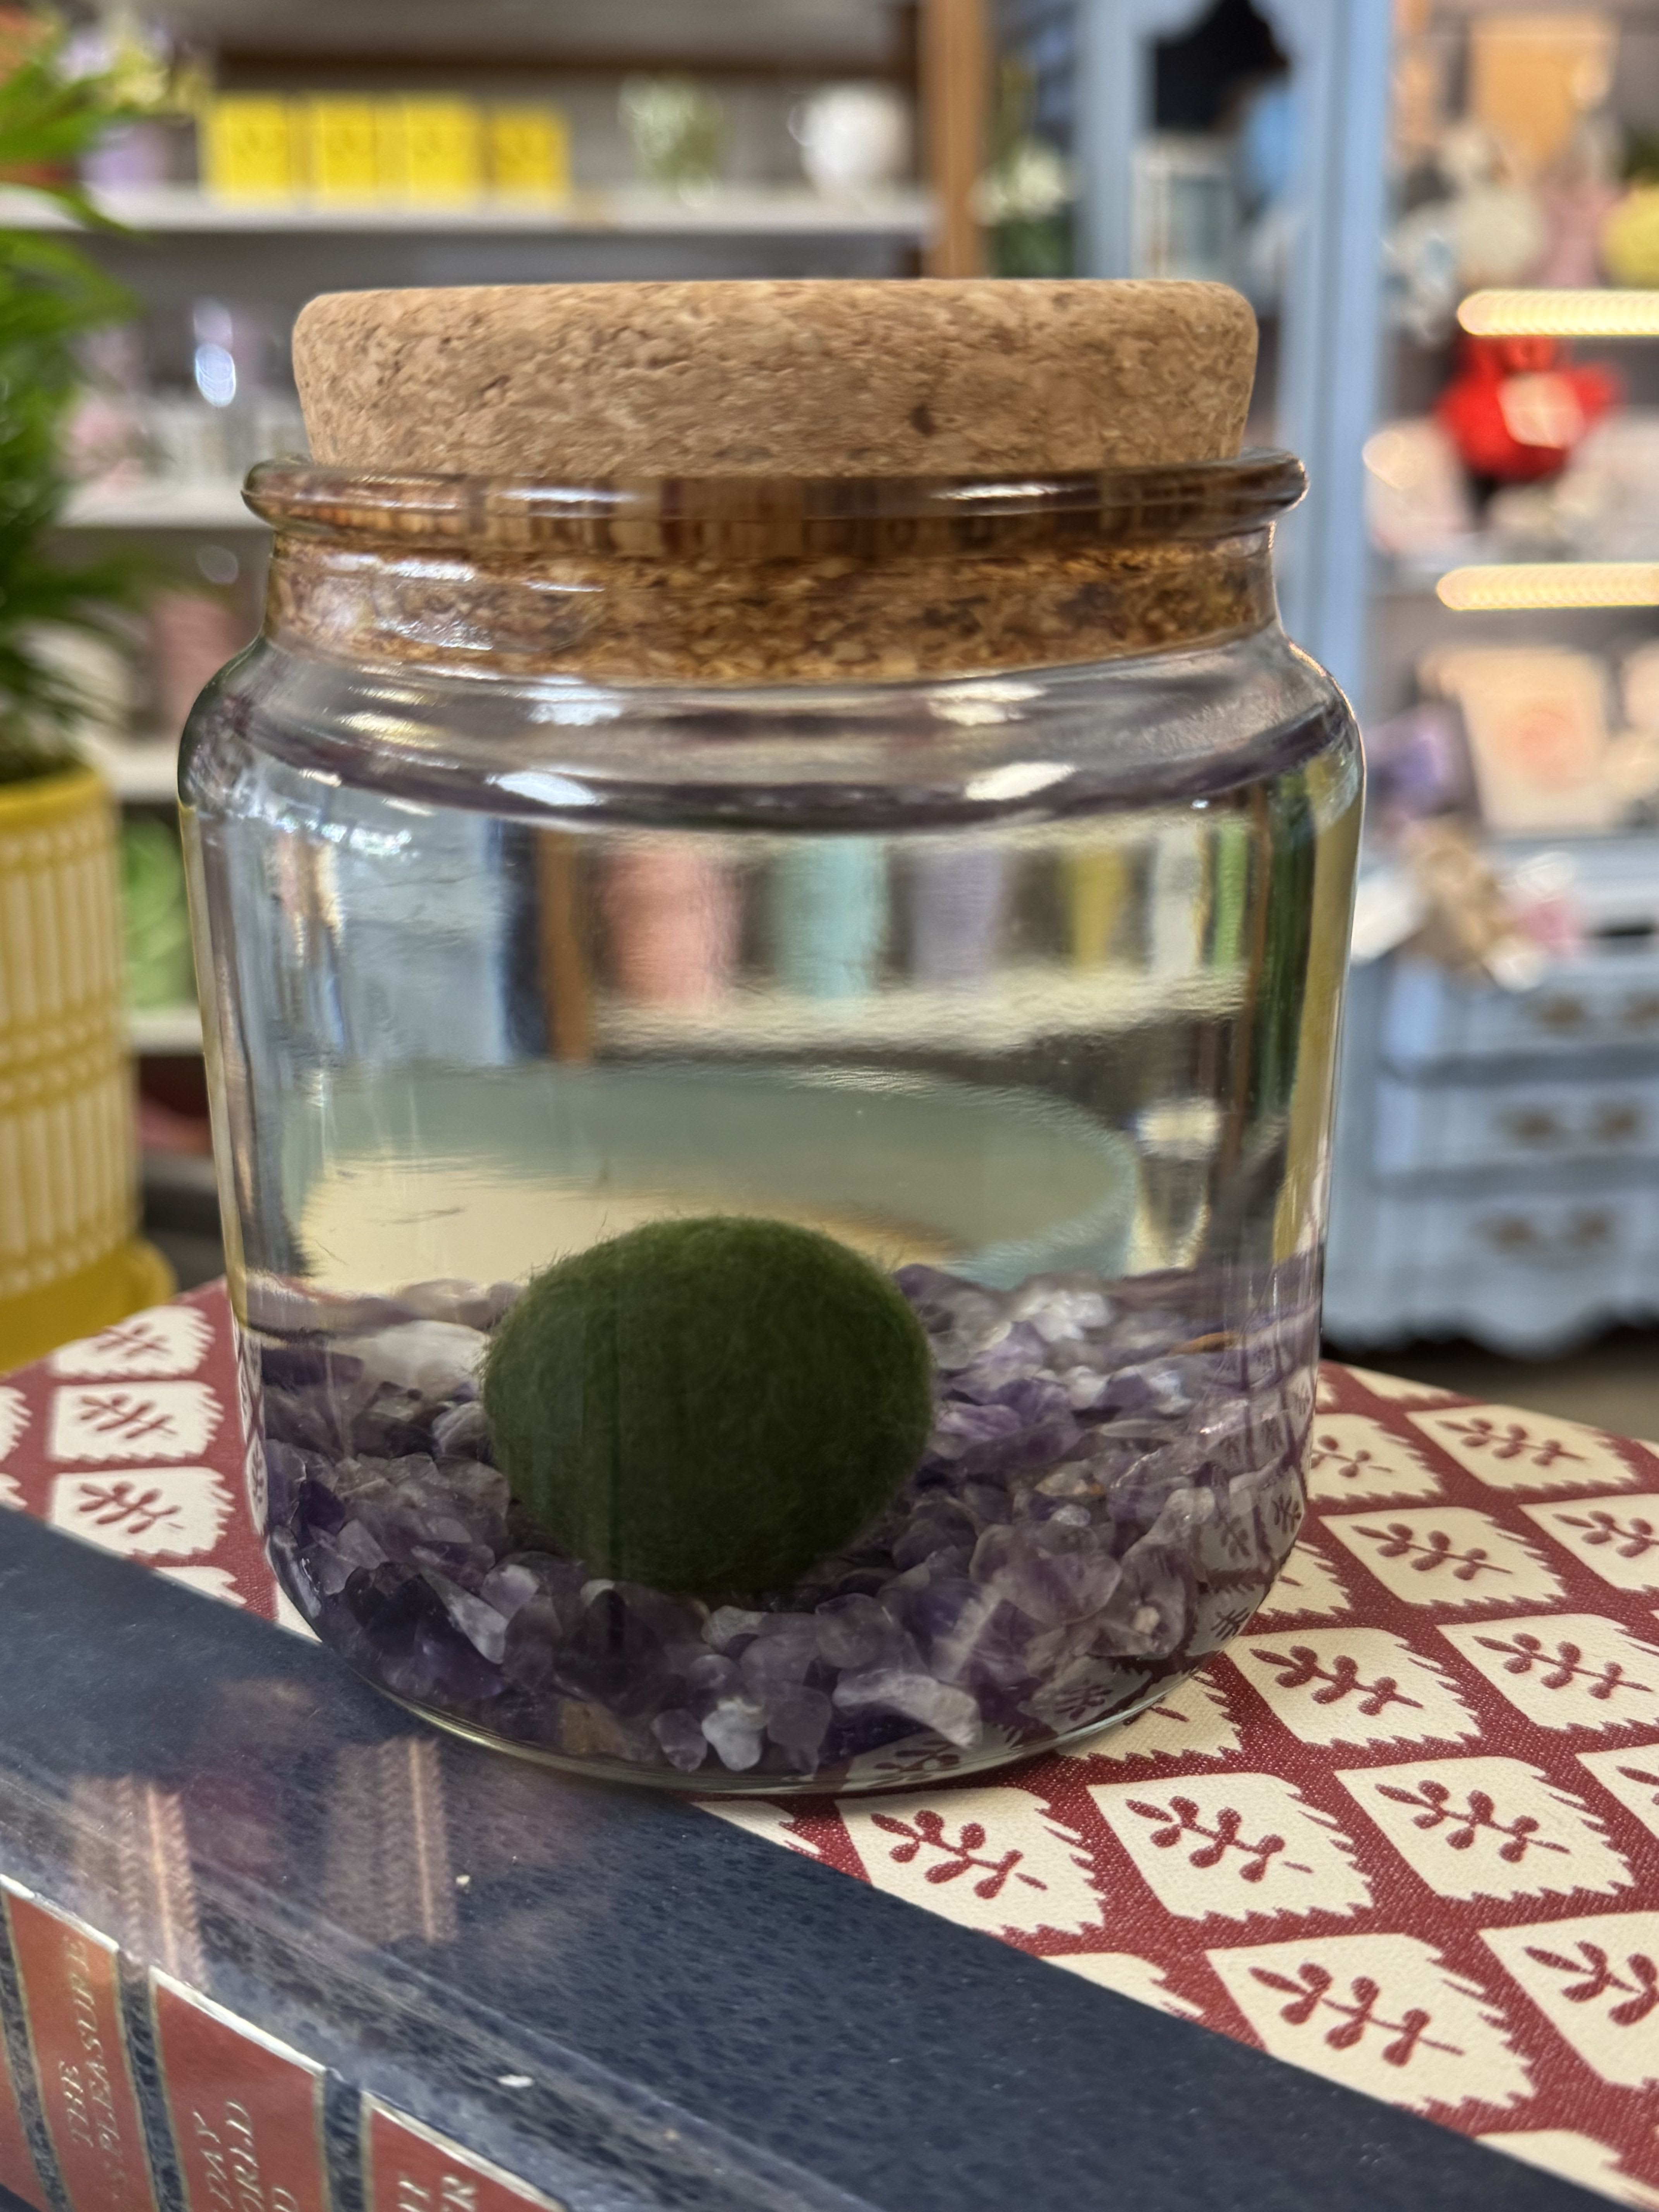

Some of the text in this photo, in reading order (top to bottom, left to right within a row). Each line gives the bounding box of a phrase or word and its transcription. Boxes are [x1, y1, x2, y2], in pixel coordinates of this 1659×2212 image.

[63, 1935, 122, 2158] PLEASURE
[58, 2060, 94, 2148] THE
[225, 2100, 265, 2212] ORLD
[192, 2111, 234, 2209] DAY
